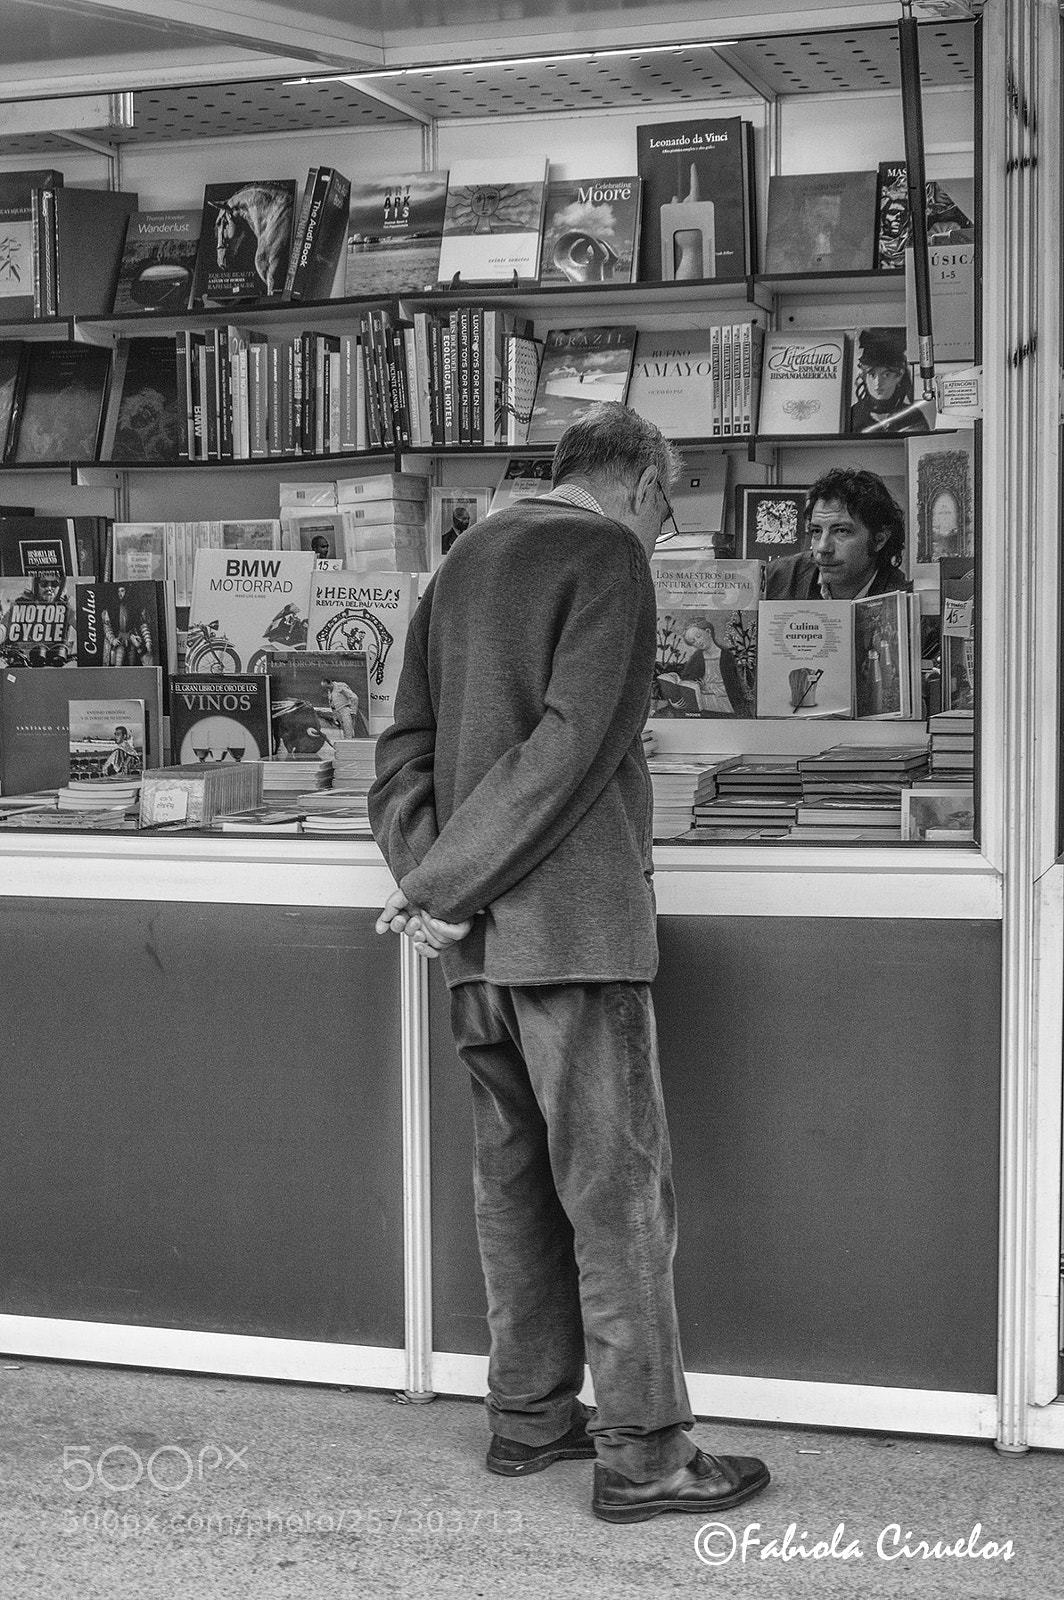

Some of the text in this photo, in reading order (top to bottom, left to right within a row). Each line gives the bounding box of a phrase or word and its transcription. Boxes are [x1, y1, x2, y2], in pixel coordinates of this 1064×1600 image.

[649, 131, 728, 148] Leonardo da Vinci
[385, 184, 411, 196] ART
[594, 182, 632, 190] Celebrating
[577, 186, 632, 202] Moore
[384, 196, 410, 208] ARK
[384, 206, 410, 220] TIS
[138, 223, 190, 234] Wanderlust
[300, 200, 321, 268] The Audi Book
[941, 270, 956, 280] 1-5
[554, 334, 626, 347] BRAZIL
[652, 350, 690, 358] RUFINO
[768, 343, 842, 372] Literatura
[194, 405, 202, 437] BMW
[226, 560, 281, 578] BMW
[318, 561, 329, 571] 15
[656, 570, 674, 579] LOS
[676, 572, 722, 580] MAESTROS
[210, 578, 293, 593] MOTORRAD
[12, 605, 66, 623] MOTOR
[82, 590, 98, 654] Carolus
[790, 622, 819, 630] Culina
[9, 624, 64, 642] CYCLE
[786, 633, 823, 641] europea
[182, 694, 251, 711] VINOS
